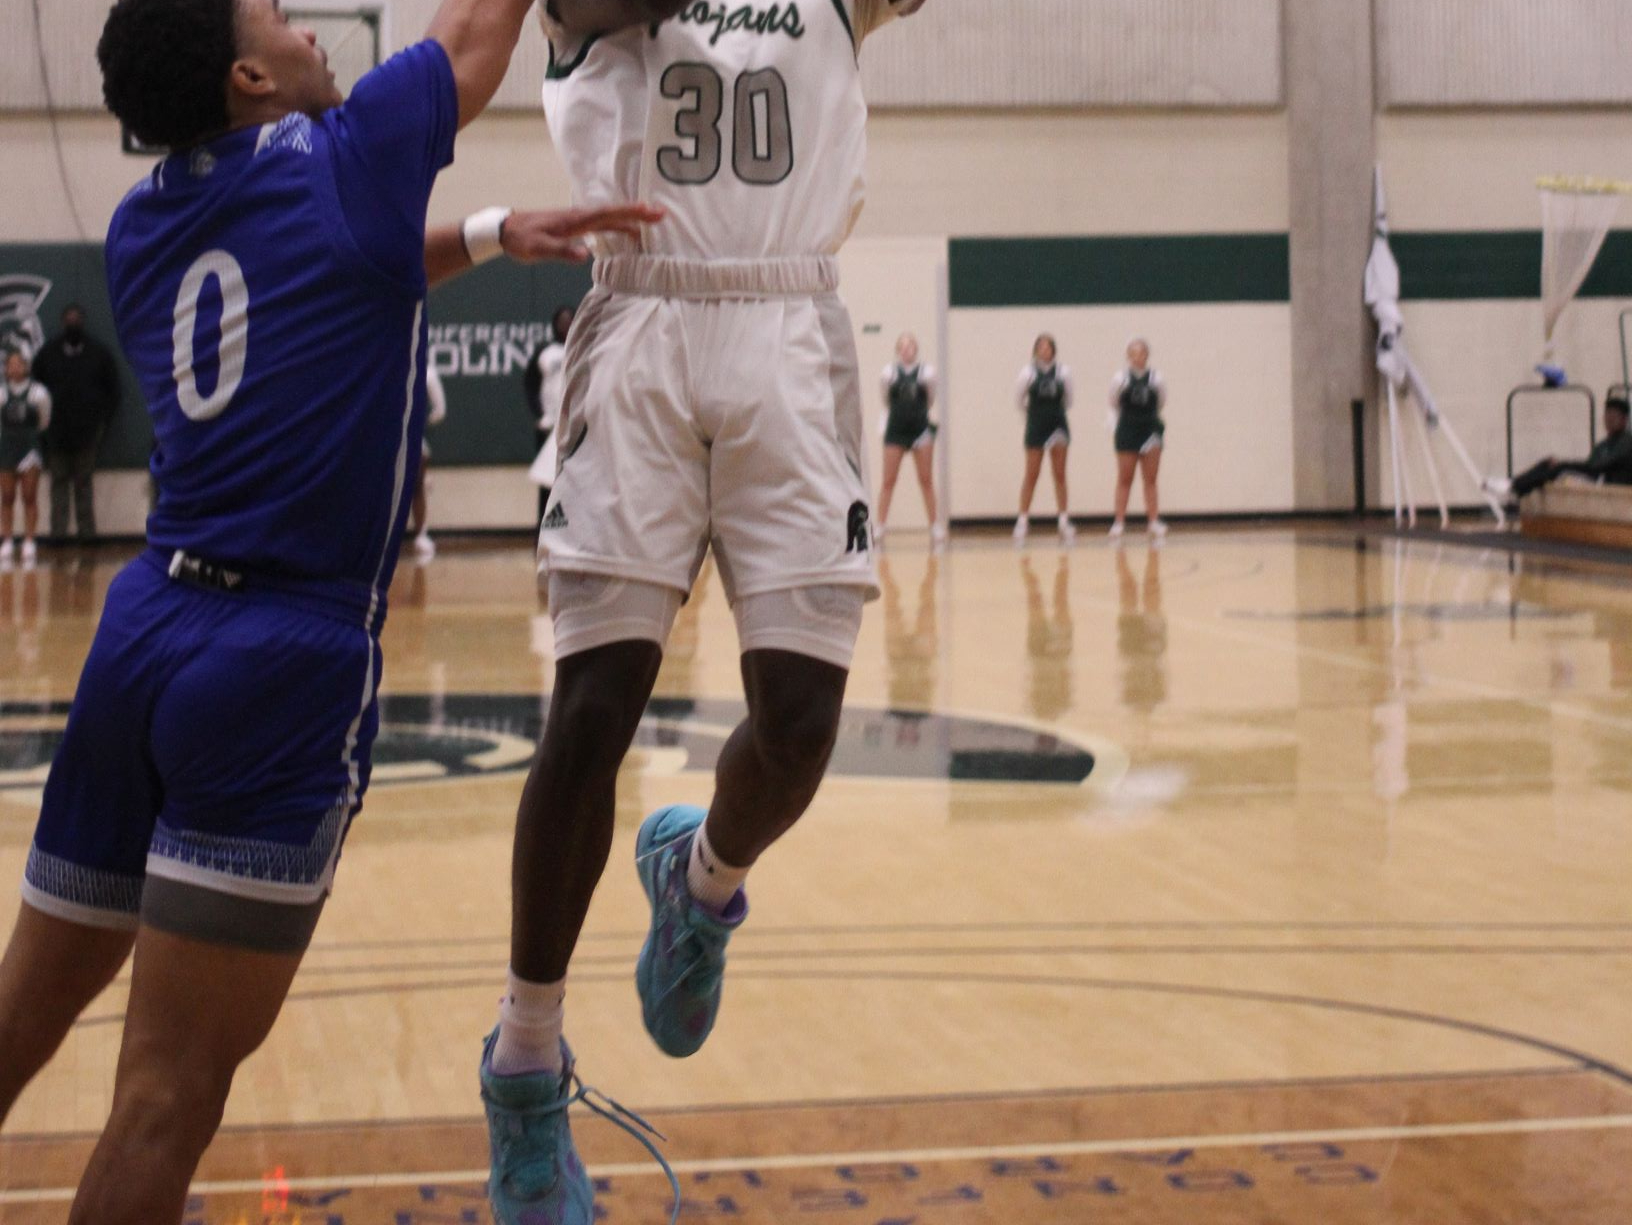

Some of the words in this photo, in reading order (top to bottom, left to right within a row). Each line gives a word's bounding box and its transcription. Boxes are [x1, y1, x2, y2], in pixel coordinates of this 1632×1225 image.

[656, 61, 793, 186] 30
[172, 249, 249, 421] 0
[427, 342, 537, 375] OLIN
